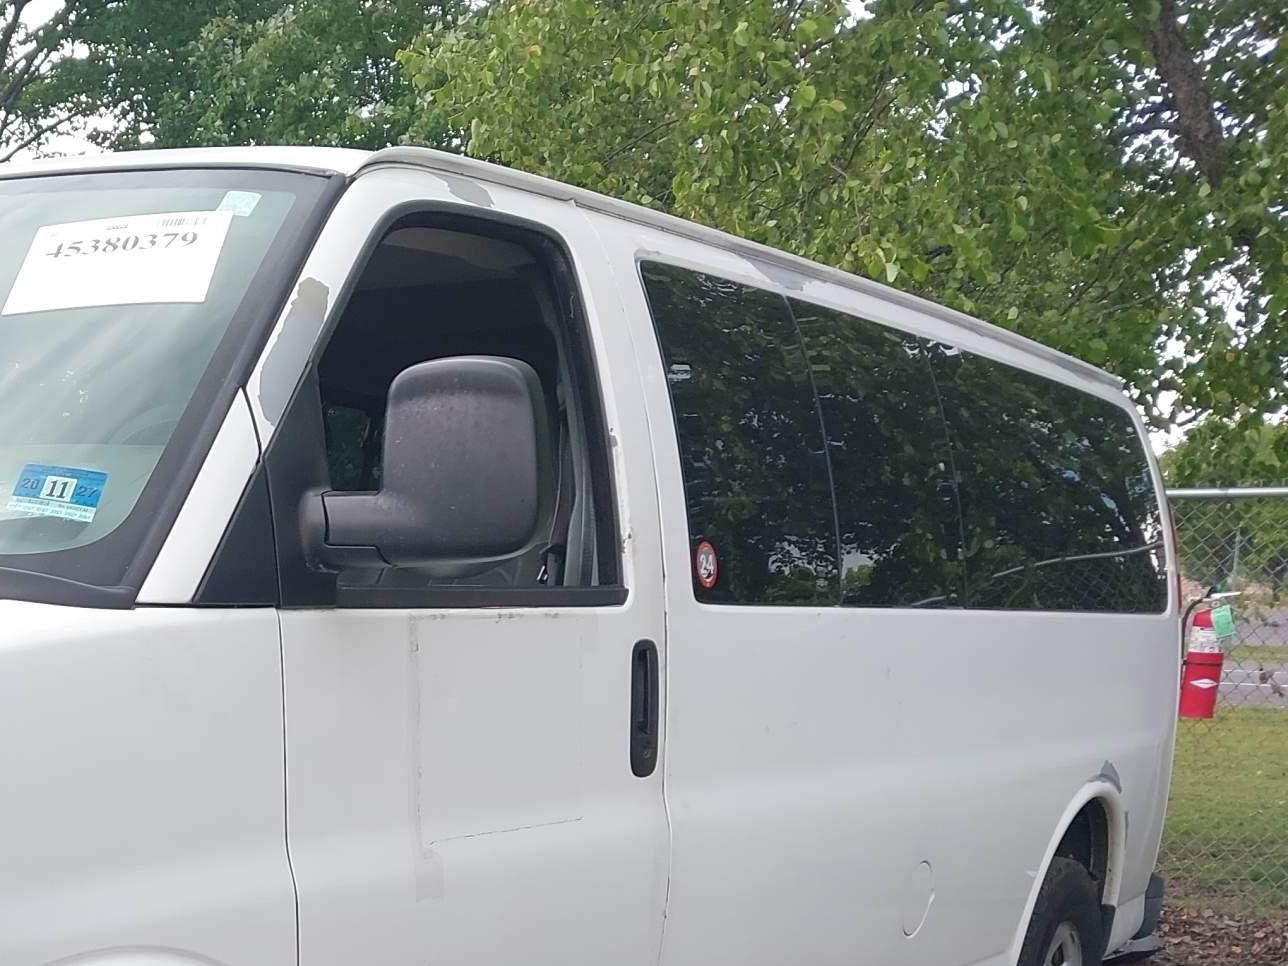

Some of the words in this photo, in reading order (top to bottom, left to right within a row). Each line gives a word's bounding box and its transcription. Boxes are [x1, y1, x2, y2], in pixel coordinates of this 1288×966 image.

[45, 231, 198, 258] 45380379
[23, 478, 39, 489] 20
[45, 480, 70, 499] 11
[700, 553, 714, 577] 24
